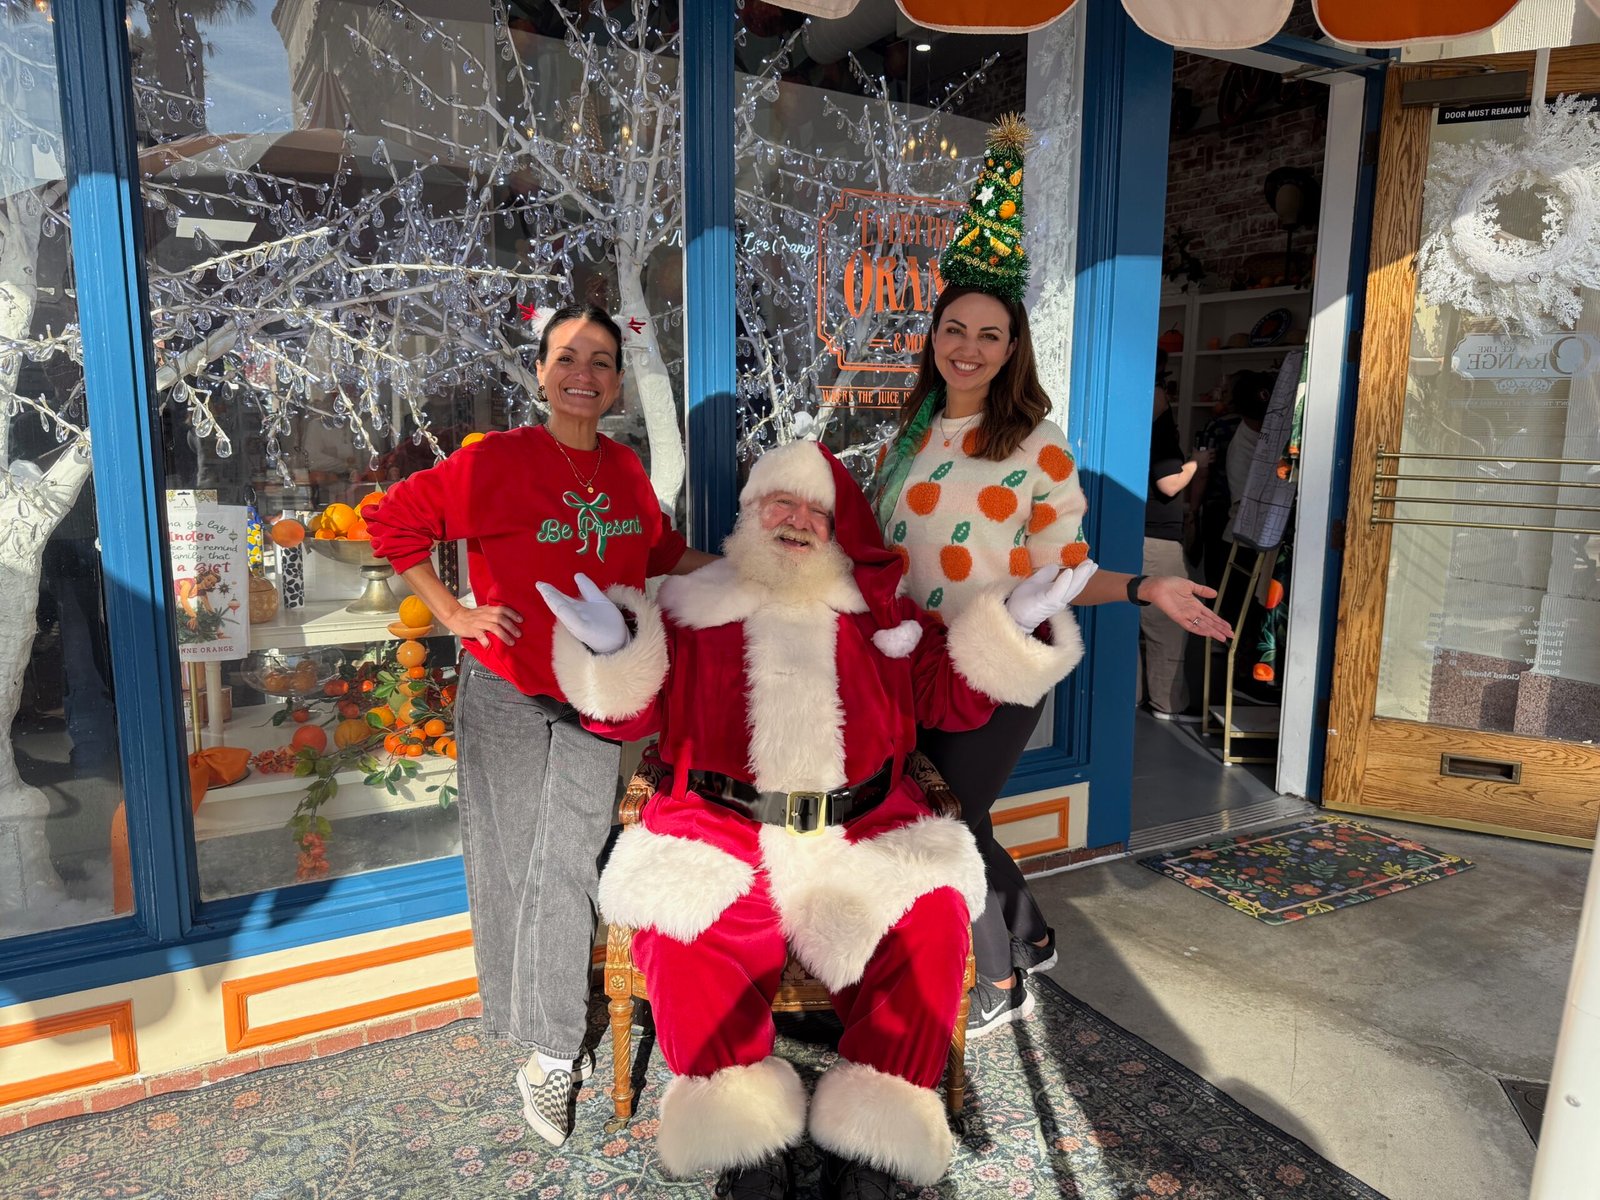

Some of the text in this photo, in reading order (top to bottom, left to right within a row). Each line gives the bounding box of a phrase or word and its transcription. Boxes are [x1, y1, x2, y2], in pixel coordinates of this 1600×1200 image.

[1445, 109, 1466, 119] DOOR
[1467, 108, 1490, 118] MUST
[1491, 106, 1522, 115] REMAIN
[843, 249, 946, 318] ORAN
[858, 391, 873, 404] THE
[877, 391, 900, 405] JUICE
[187, 521, 203, 530] go
[207, 520, 228, 534] lay
[537, 514, 642, 543] Be Present
[203, 545, 238, 553] remind
[208, 552, 230, 560] that
[200, 645, 234, 654] ORANGE
